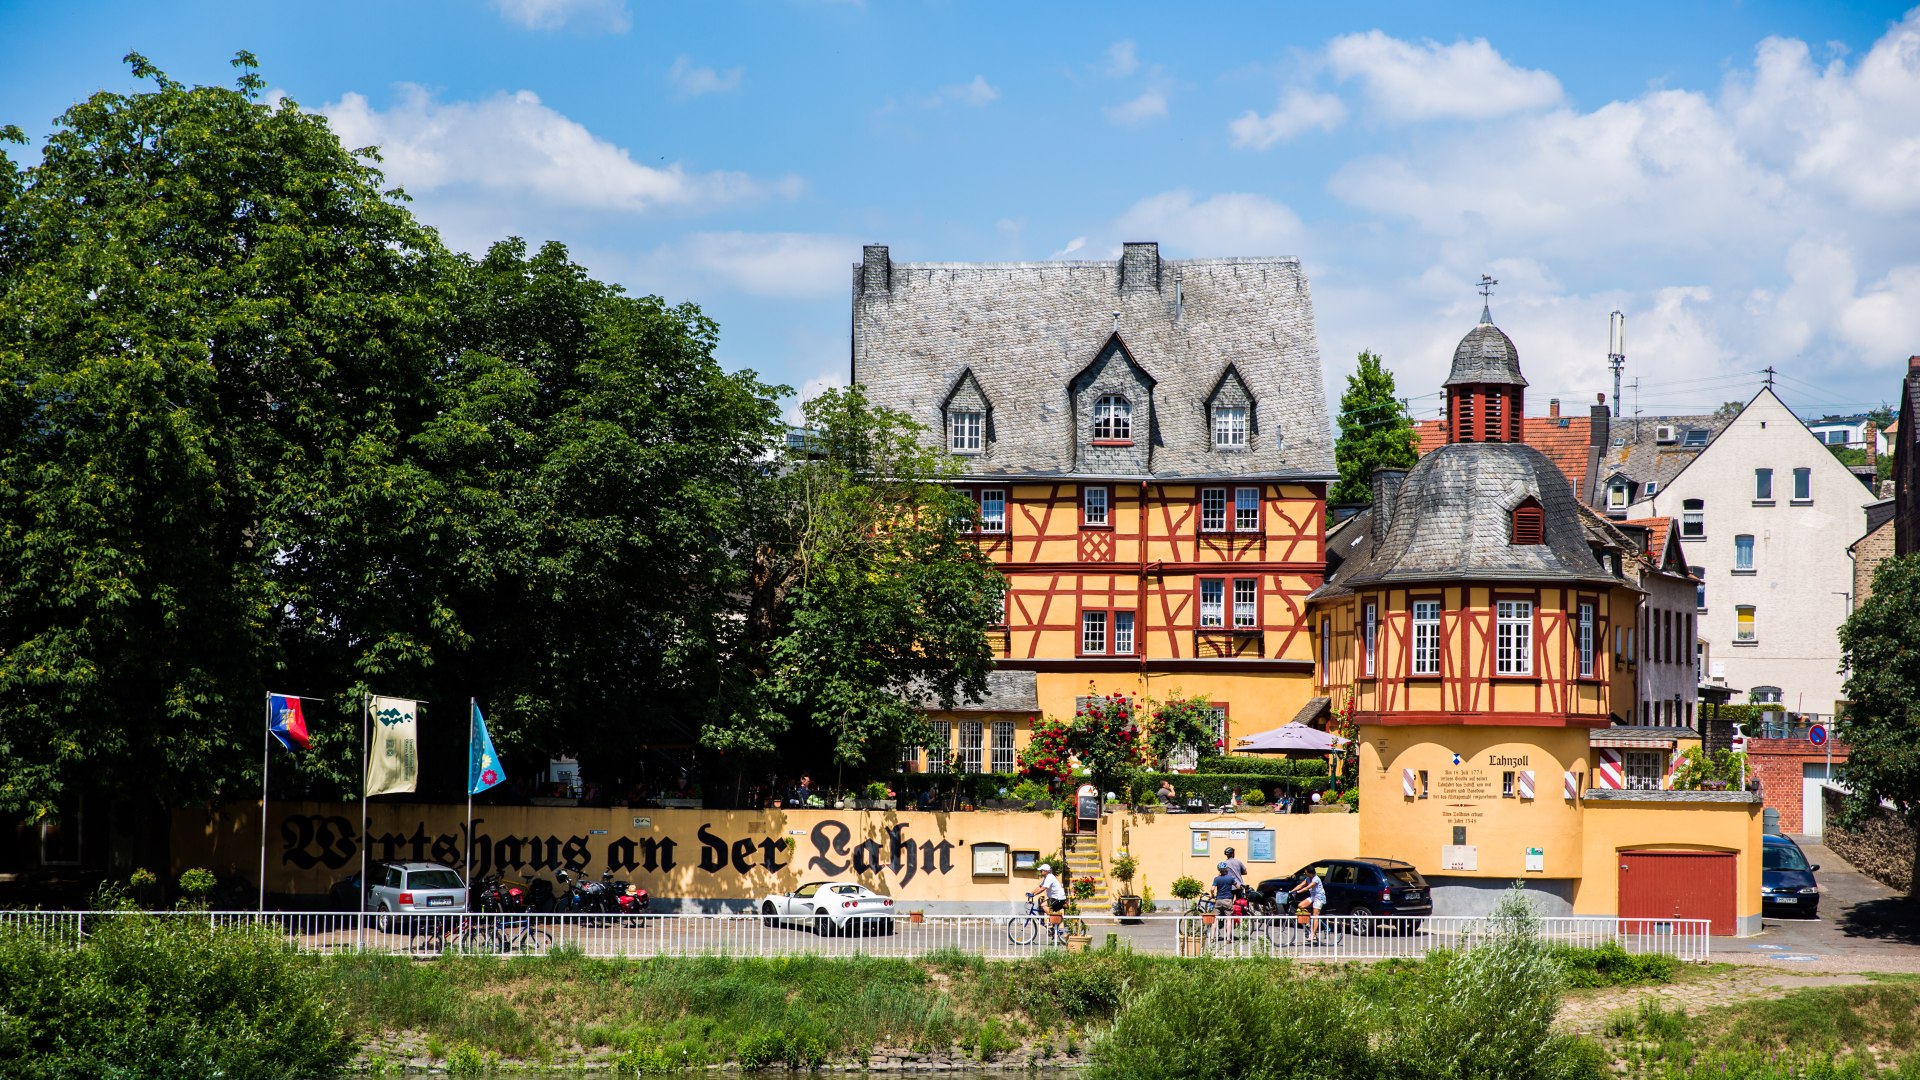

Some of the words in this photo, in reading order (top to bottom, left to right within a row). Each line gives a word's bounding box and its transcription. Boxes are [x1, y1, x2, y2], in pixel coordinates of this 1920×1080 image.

[1489, 755, 1528, 768] Lahnzoll
[281, 814, 592, 880] Wirtshaus
[607, 835, 678, 873] an
[697, 823, 787, 874] der
[808, 819, 956, 889] Lahn
